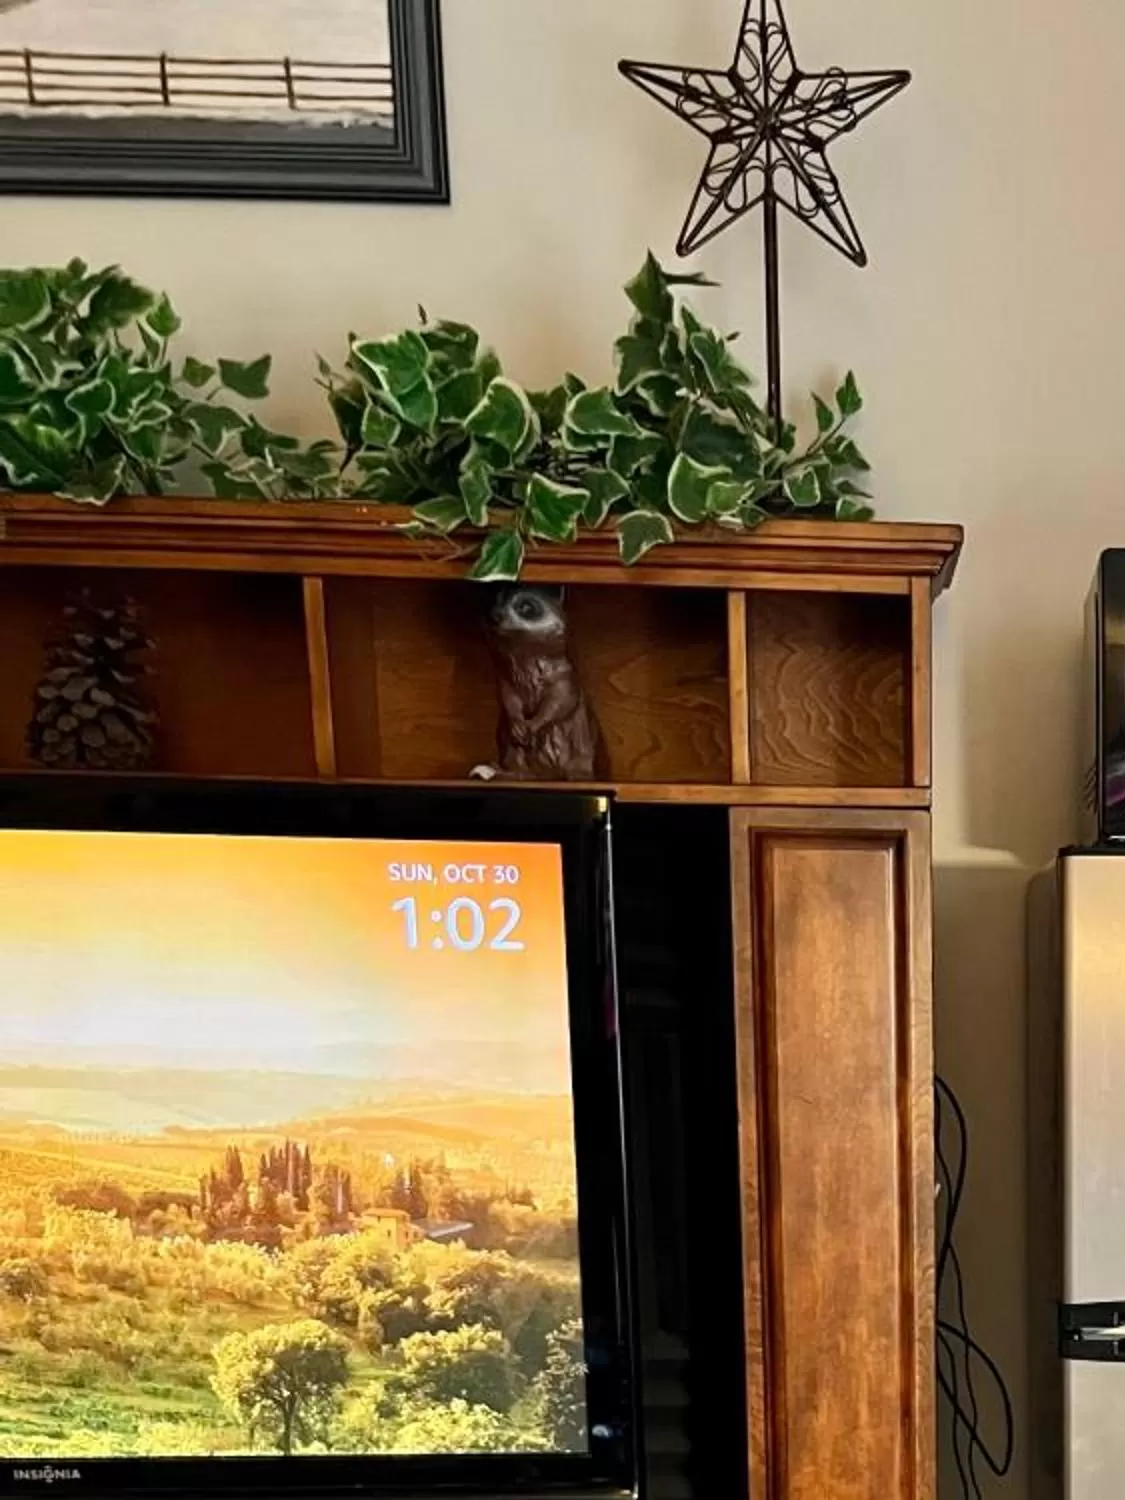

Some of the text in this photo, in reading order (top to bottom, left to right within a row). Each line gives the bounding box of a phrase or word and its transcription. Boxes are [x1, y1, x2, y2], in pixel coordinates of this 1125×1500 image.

[388, 863, 519, 885] SUN, OCT 30
[391, 896, 525, 950] 1:02
[13, 1466, 81, 1482] INSIGNIA
